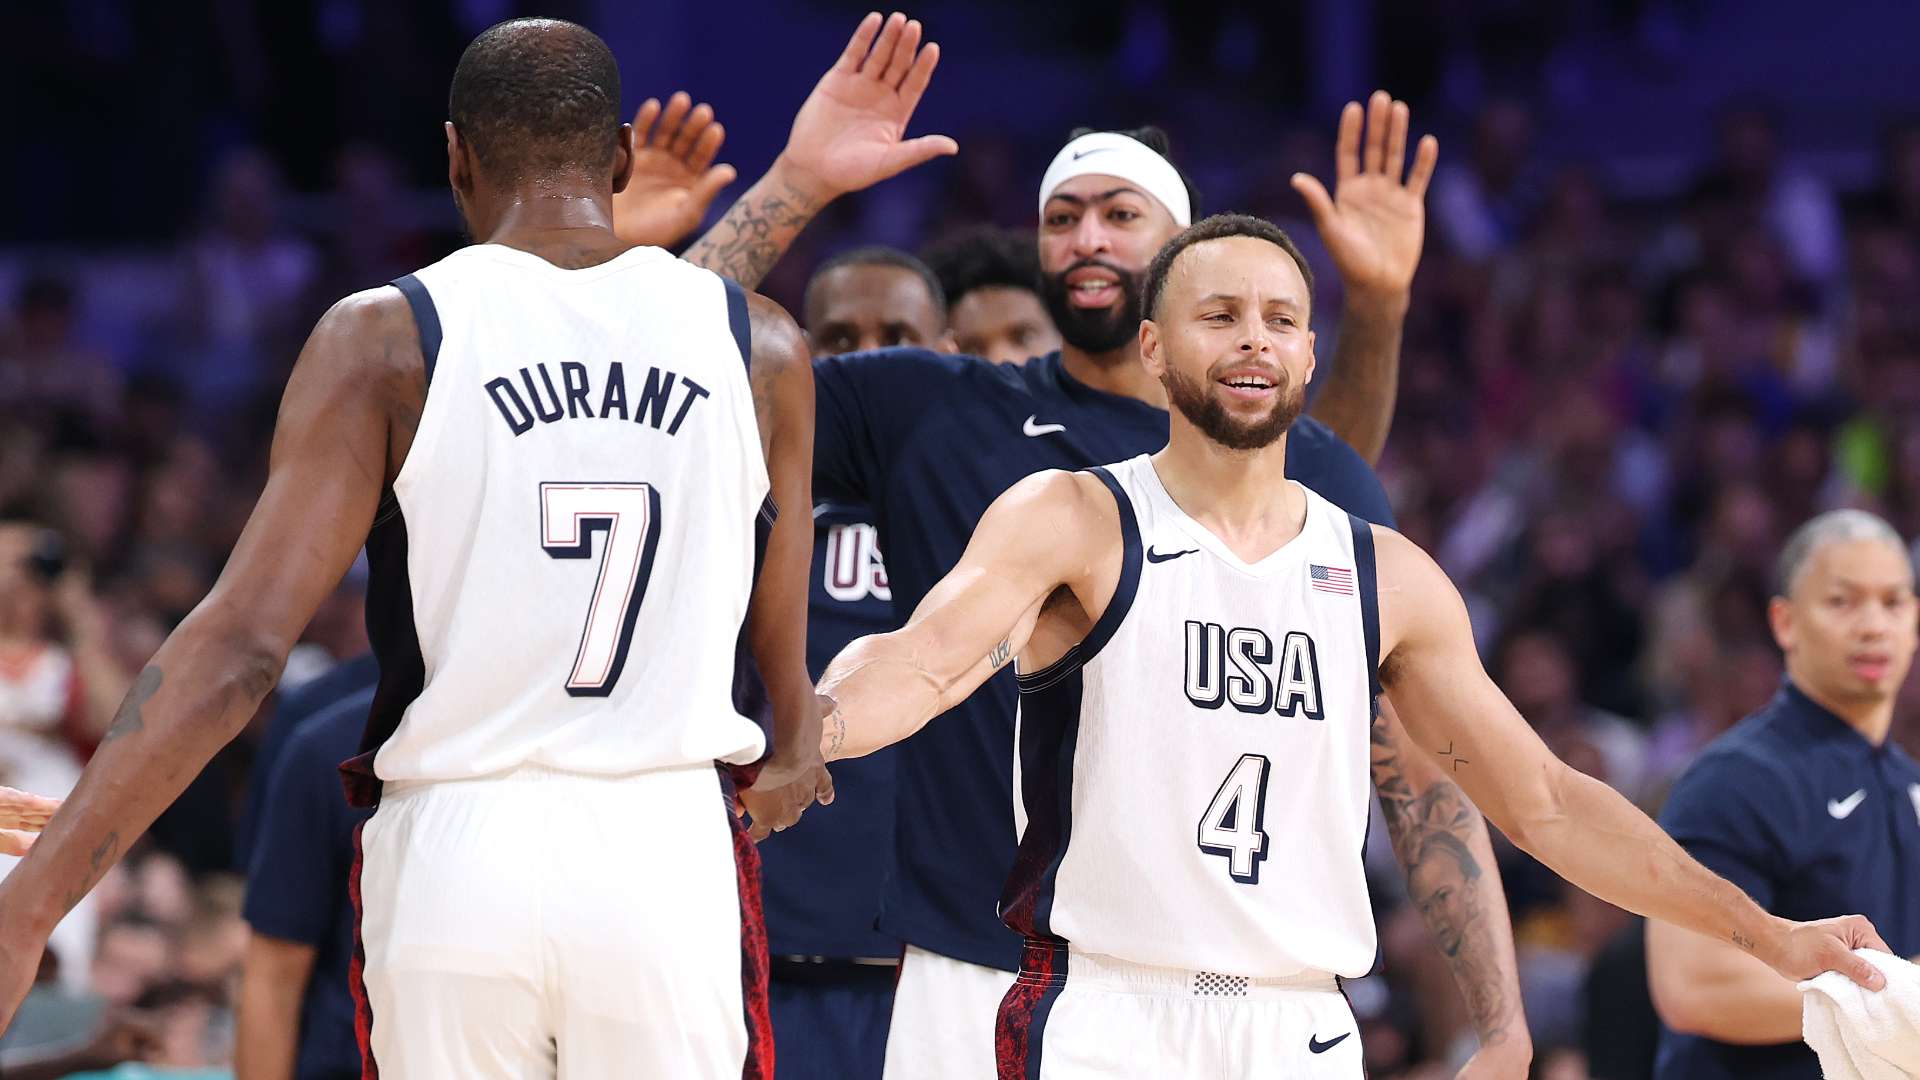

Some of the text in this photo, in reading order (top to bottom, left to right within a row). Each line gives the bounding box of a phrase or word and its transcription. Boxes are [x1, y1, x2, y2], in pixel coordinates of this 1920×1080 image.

[484, 361, 710, 437] DURANT
[539, 481, 661, 697] 7
[1184, 620, 1325, 720] USA
[1198, 753, 1271, 885] 4
